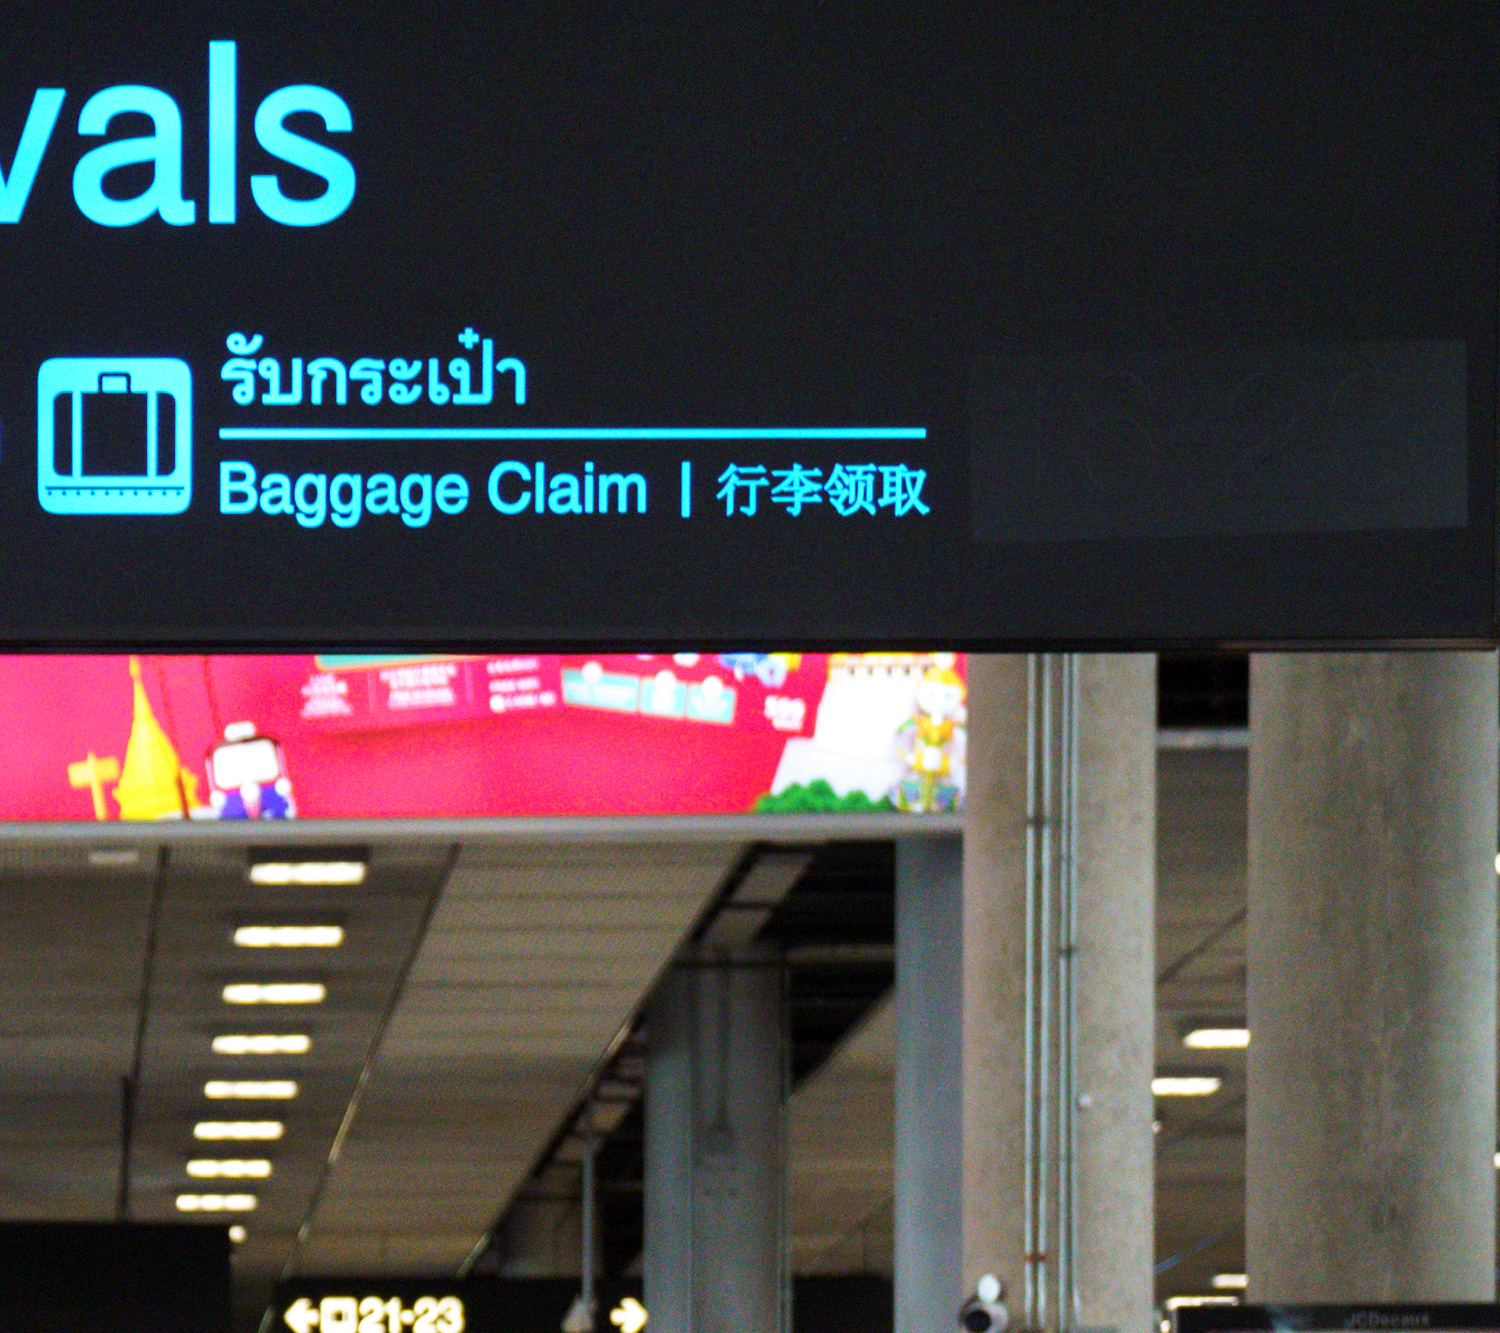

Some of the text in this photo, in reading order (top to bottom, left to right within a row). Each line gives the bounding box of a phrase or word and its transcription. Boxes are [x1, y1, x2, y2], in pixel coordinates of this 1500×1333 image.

[219, 326, 527, 406] รับกระเป๋า
[218, 459, 648, 529] Baggage Claim
[715, 462, 931, 518] 行李领取
